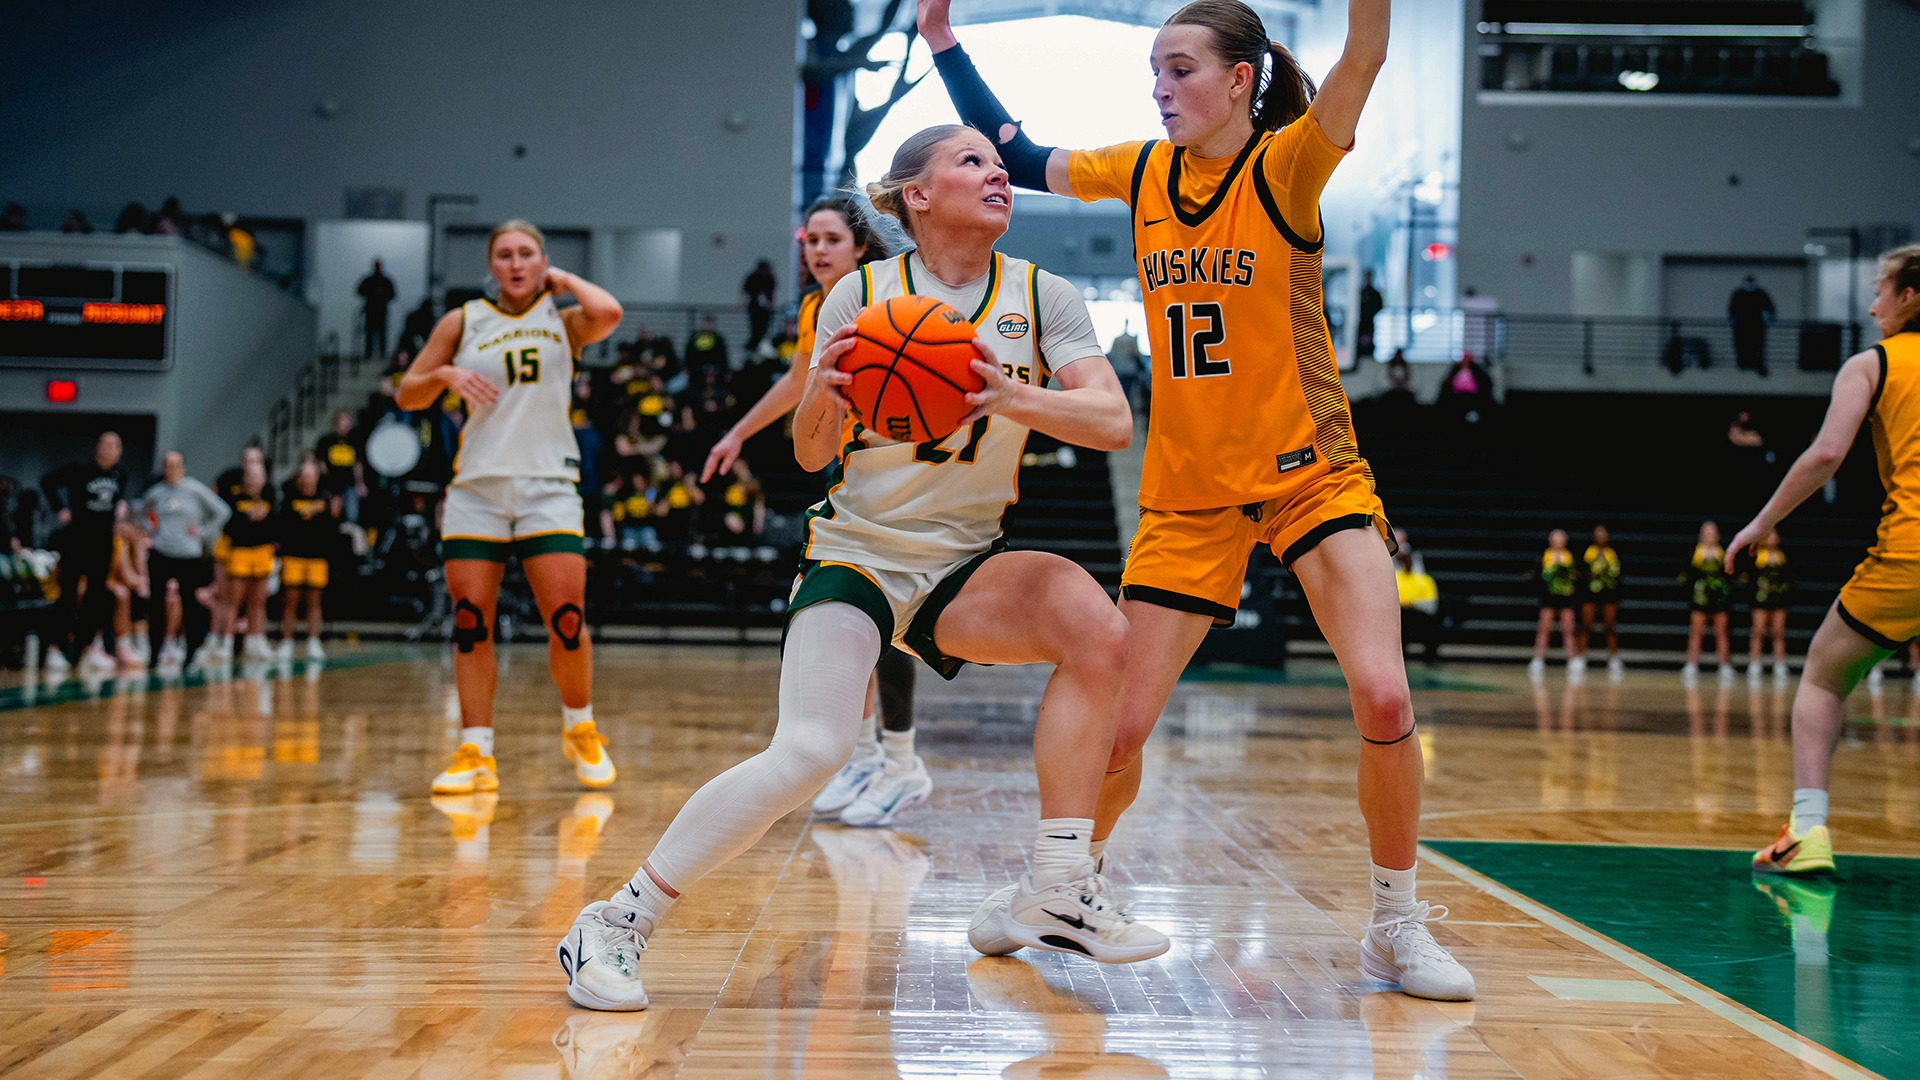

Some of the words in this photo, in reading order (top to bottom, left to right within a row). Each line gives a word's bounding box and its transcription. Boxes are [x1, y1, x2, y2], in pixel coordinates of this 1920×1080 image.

[1141, 247, 1256, 292] HUSKIES
[999, 323, 1027, 331] GLIAC
[1165, 301, 1232, 379] 12
[503, 346, 540, 387] 15
